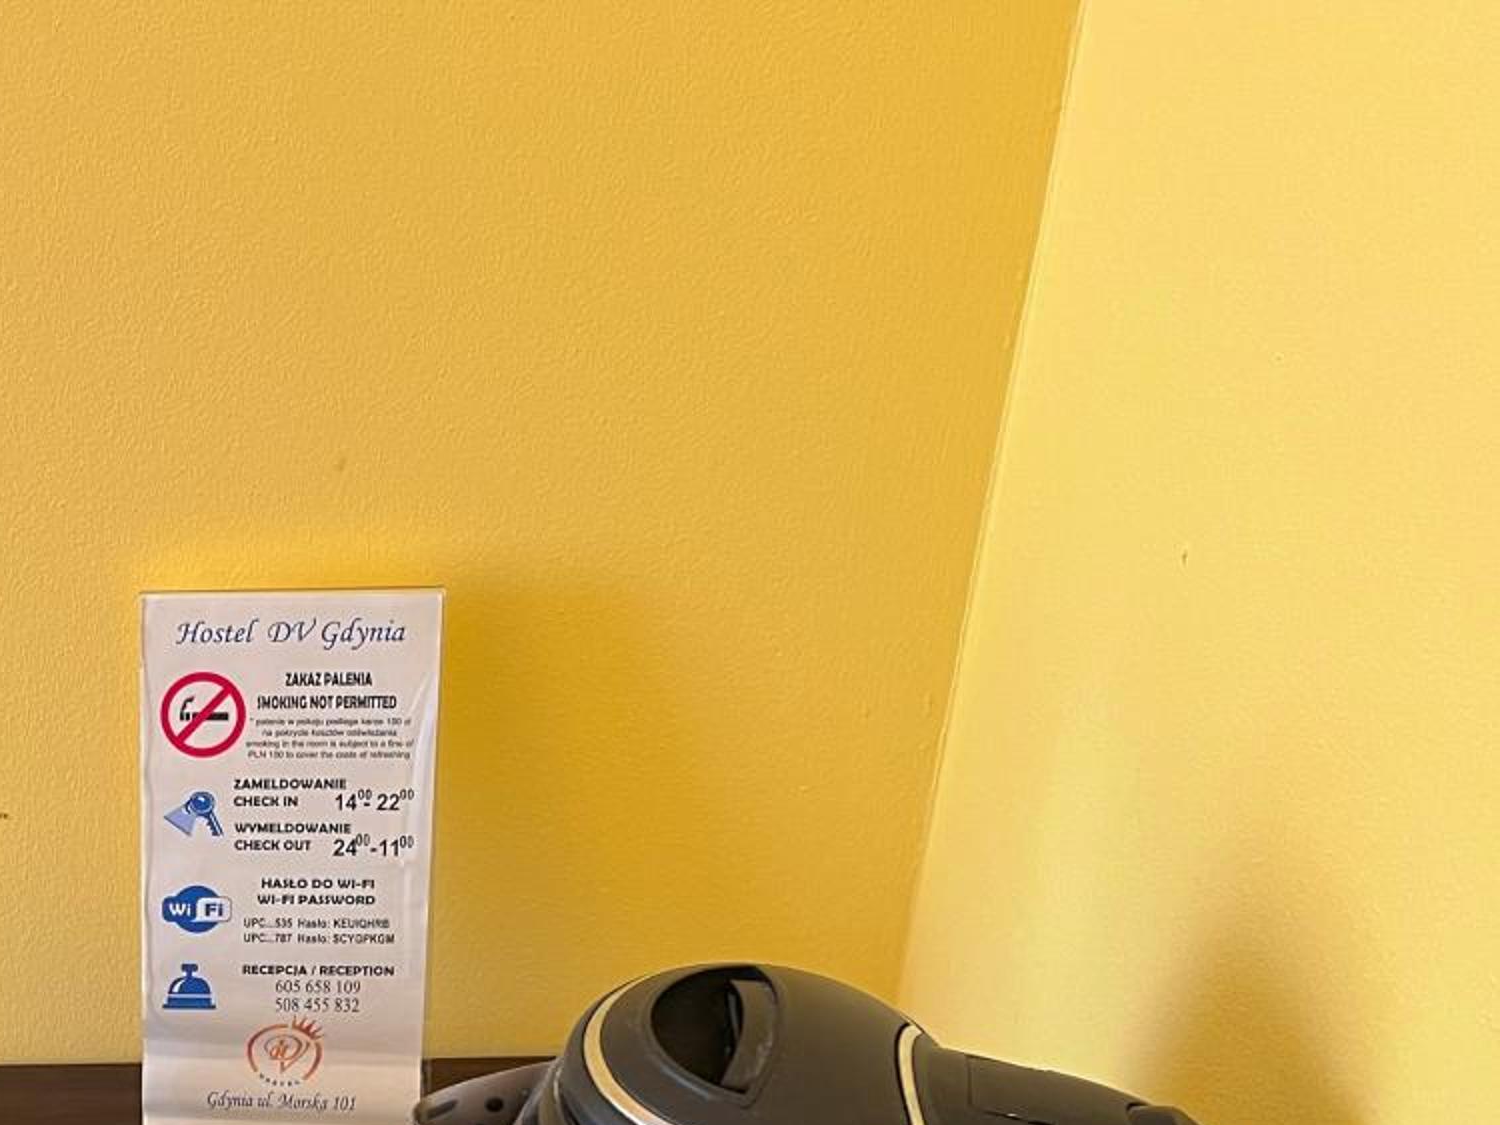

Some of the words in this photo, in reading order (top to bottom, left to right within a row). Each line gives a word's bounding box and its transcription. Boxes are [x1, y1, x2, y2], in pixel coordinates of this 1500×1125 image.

[176, 618, 259, 644] Hostel
[268, 617, 317, 643] DV
[321, 617, 406, 651] Gdynia
[285, 672, 322, 686] ZAKAZ
[324, 672, 373, 686] PALENIA
[257, 695, 307, 709] SMOKING
[310, 695, 335, 709] NOT
[336, 695, 397, 709] PERMITTED
[233, 779, 347, 790] ZAMELDOWANIE
[233, 796, 281, 807] CHECK
[283, 796, 299, 807] IN
[234, 823, 351, 834] WYMELDOWANIE
[234, 840, 281, 851] CHECK
[283, 840, 312, 851] OUT
[261, 879, 308, 889] HASŁO
[311, 879, 334, 889] DO
[337, 879, 375, 889] WI-FI
[257, 895, 295, 905] WI-FI
[298, 895, 376, 905] PASSWORD
[242, 965, 307, 976] RECEPCJA
[319, 965, 395, 976] RECEPTION
[275, 980, 301, 994] 605
[305, 980, 332, 994] 658
[336, 980, 361, 994] 109
[275, 997, 300, 1013] 508
[304, 997, 330, 1013] 455
[334, 997, 360, 1013] 832
[207, 1090, 253, 1111] Gdynia
[277, 1092, 329, 1112] Morska
[333, 1095, 357, 1111] 101
